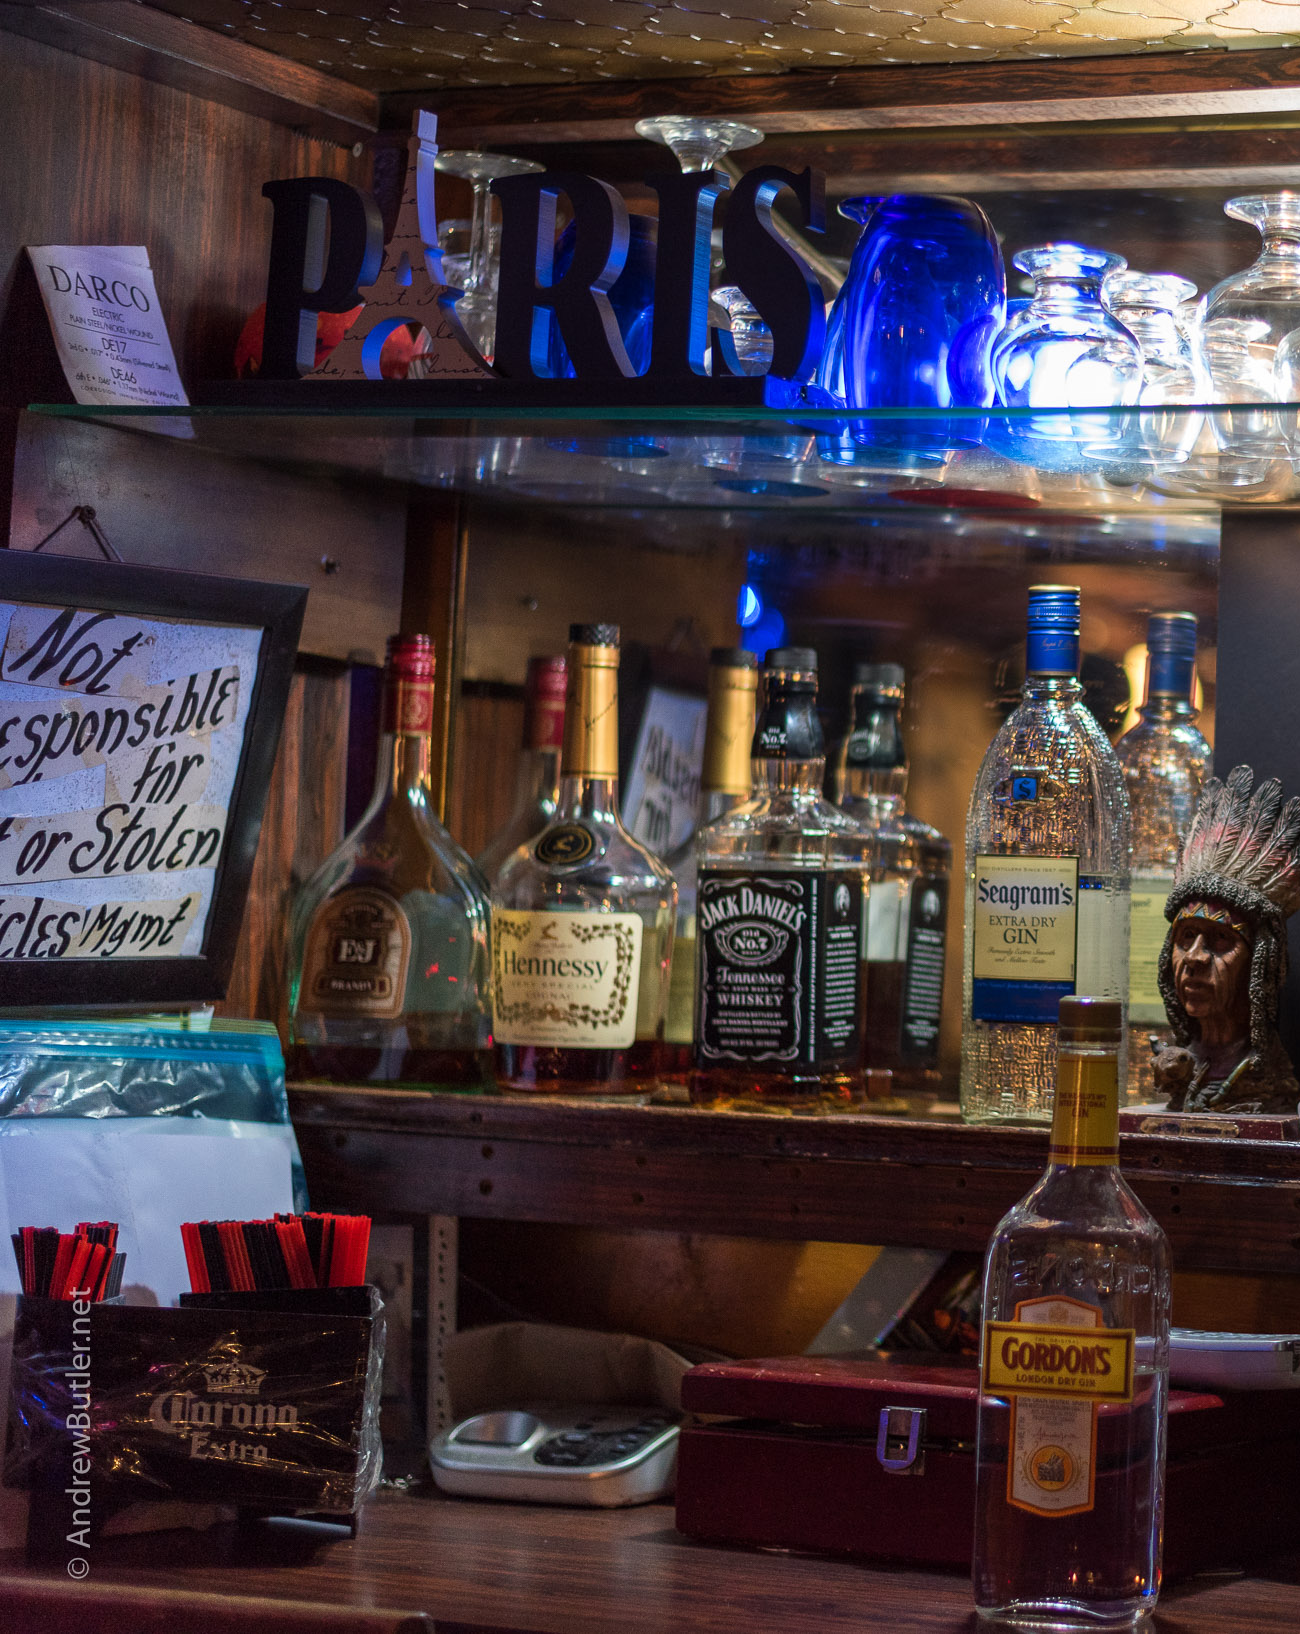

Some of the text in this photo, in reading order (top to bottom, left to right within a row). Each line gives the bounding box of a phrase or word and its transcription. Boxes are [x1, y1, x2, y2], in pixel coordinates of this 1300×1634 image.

[262, 110, 826, 380] PARIS
[46, 265, 150, 312] DARCO
[92, 307, 125, 322] ELECTRIC
[101, 337, 127, 354] DE17
[8, 605, 143, 695] Not
[132, 742, 204, 804] for
[15, 829, 74, 877] or
[69, 803, 223, 874] Stolen
[701, 886, 808, 932] JACK DANIEL'S
[977, 877, 1074, 911] Seagram's
[79, 897, 192, 957] Mgmt
[989, 915, 1057, 928] EXTRA DRY
[1003, 928, 1039, 945] GIN
[734, 936, 769, 950] No.7
[504, 950, 609, 984] Hennessy
[716, 966, 786, 985] Tennessee
[716, 993, 785, 1007] WHISKEY
[1001, 1335, 1113, 1376] GORDON'S
[1016, 1373, 1096, 1388] LONDON DRY GIN
[149, 1389, 299, 1434] Corona
[189, 1434, 269, 1464] Extra
